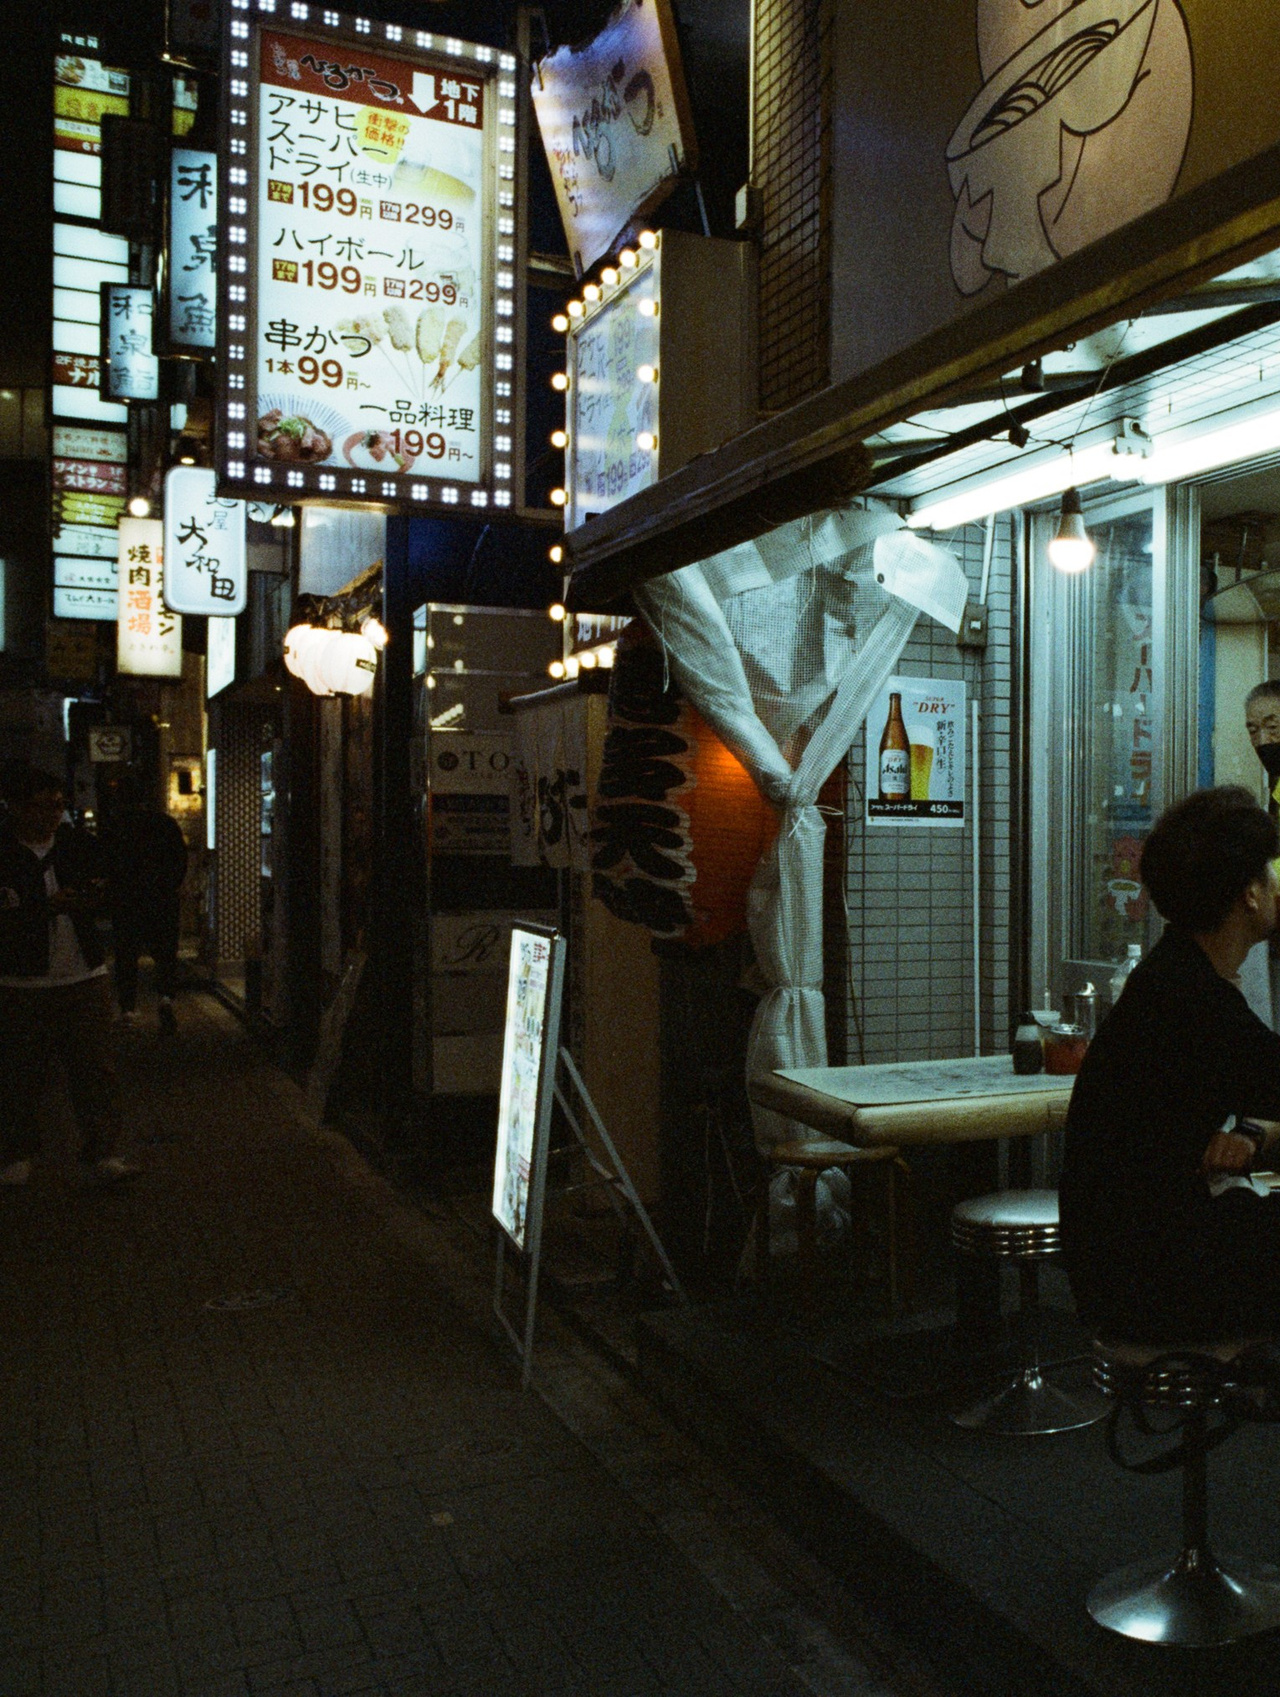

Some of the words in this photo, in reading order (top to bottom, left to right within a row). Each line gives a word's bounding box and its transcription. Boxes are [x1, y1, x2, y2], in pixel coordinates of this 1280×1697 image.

[441, 78, 479, 102] 地下
[268, 93, 358, 131] アサヒ
[443, 100, 478, 125] 1階
[267, 119, 388, 157] スーパー
[268, 147, 351, 183] ドライ
[273, 228, 425, 270] ハイボール
[264, 318, 372, 359] 串かつ
[360, 399, 476, 433] 一品料理
[173, 515, 236, 601] 大和田
[127, 543, 152, 636] 焼肉酒場
